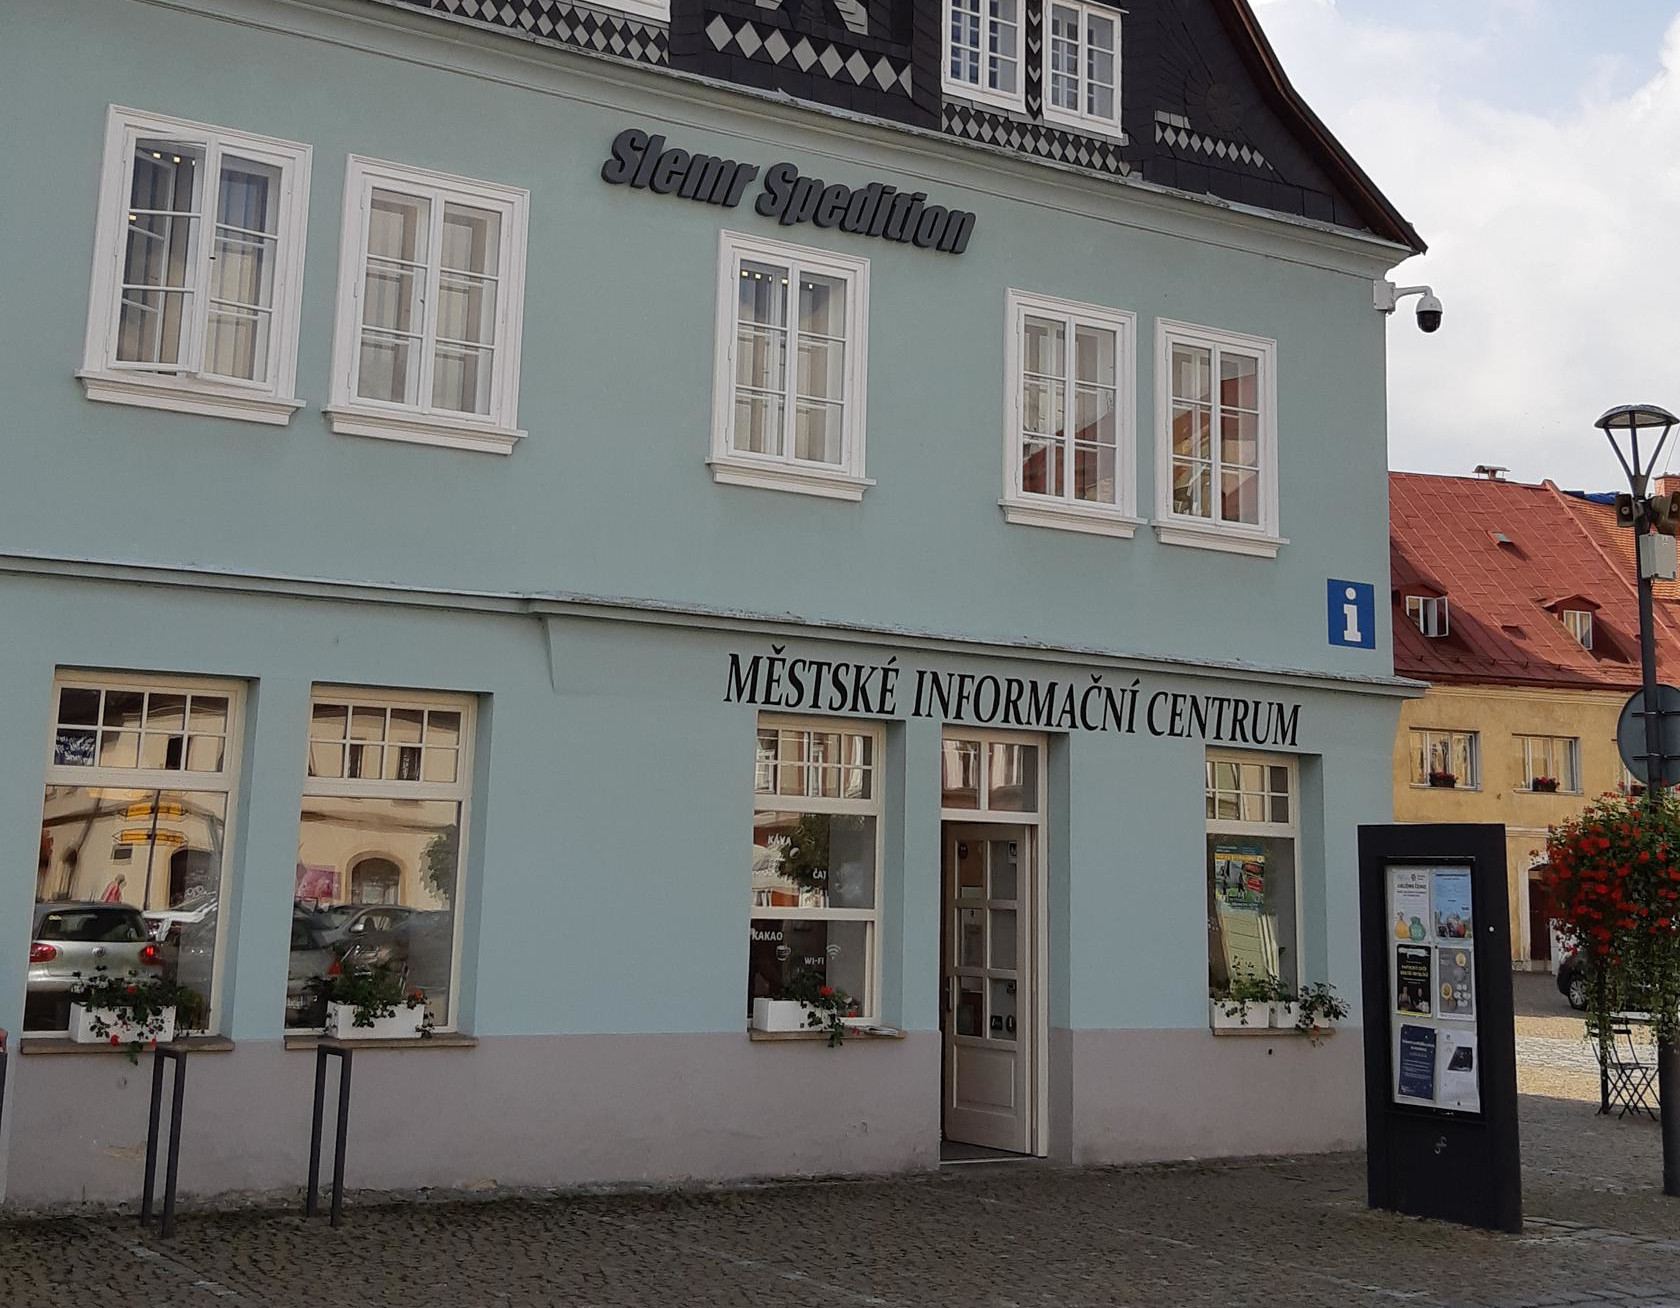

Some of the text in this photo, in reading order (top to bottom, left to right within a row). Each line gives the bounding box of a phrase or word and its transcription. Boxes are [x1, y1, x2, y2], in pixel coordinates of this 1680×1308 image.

[601, 128, 977, 254] Slemr Spedition
[724, 644, 1301, 746] MĚSTSKÉ INFORMAČNÍ CENTRUM
[767, 833, 792, 846] KÁVA
[812, 868, 827, 880] ČAJ
[751, 930, 783, 941] KAKAO
[804, 956, 824, 966] WI-FI
